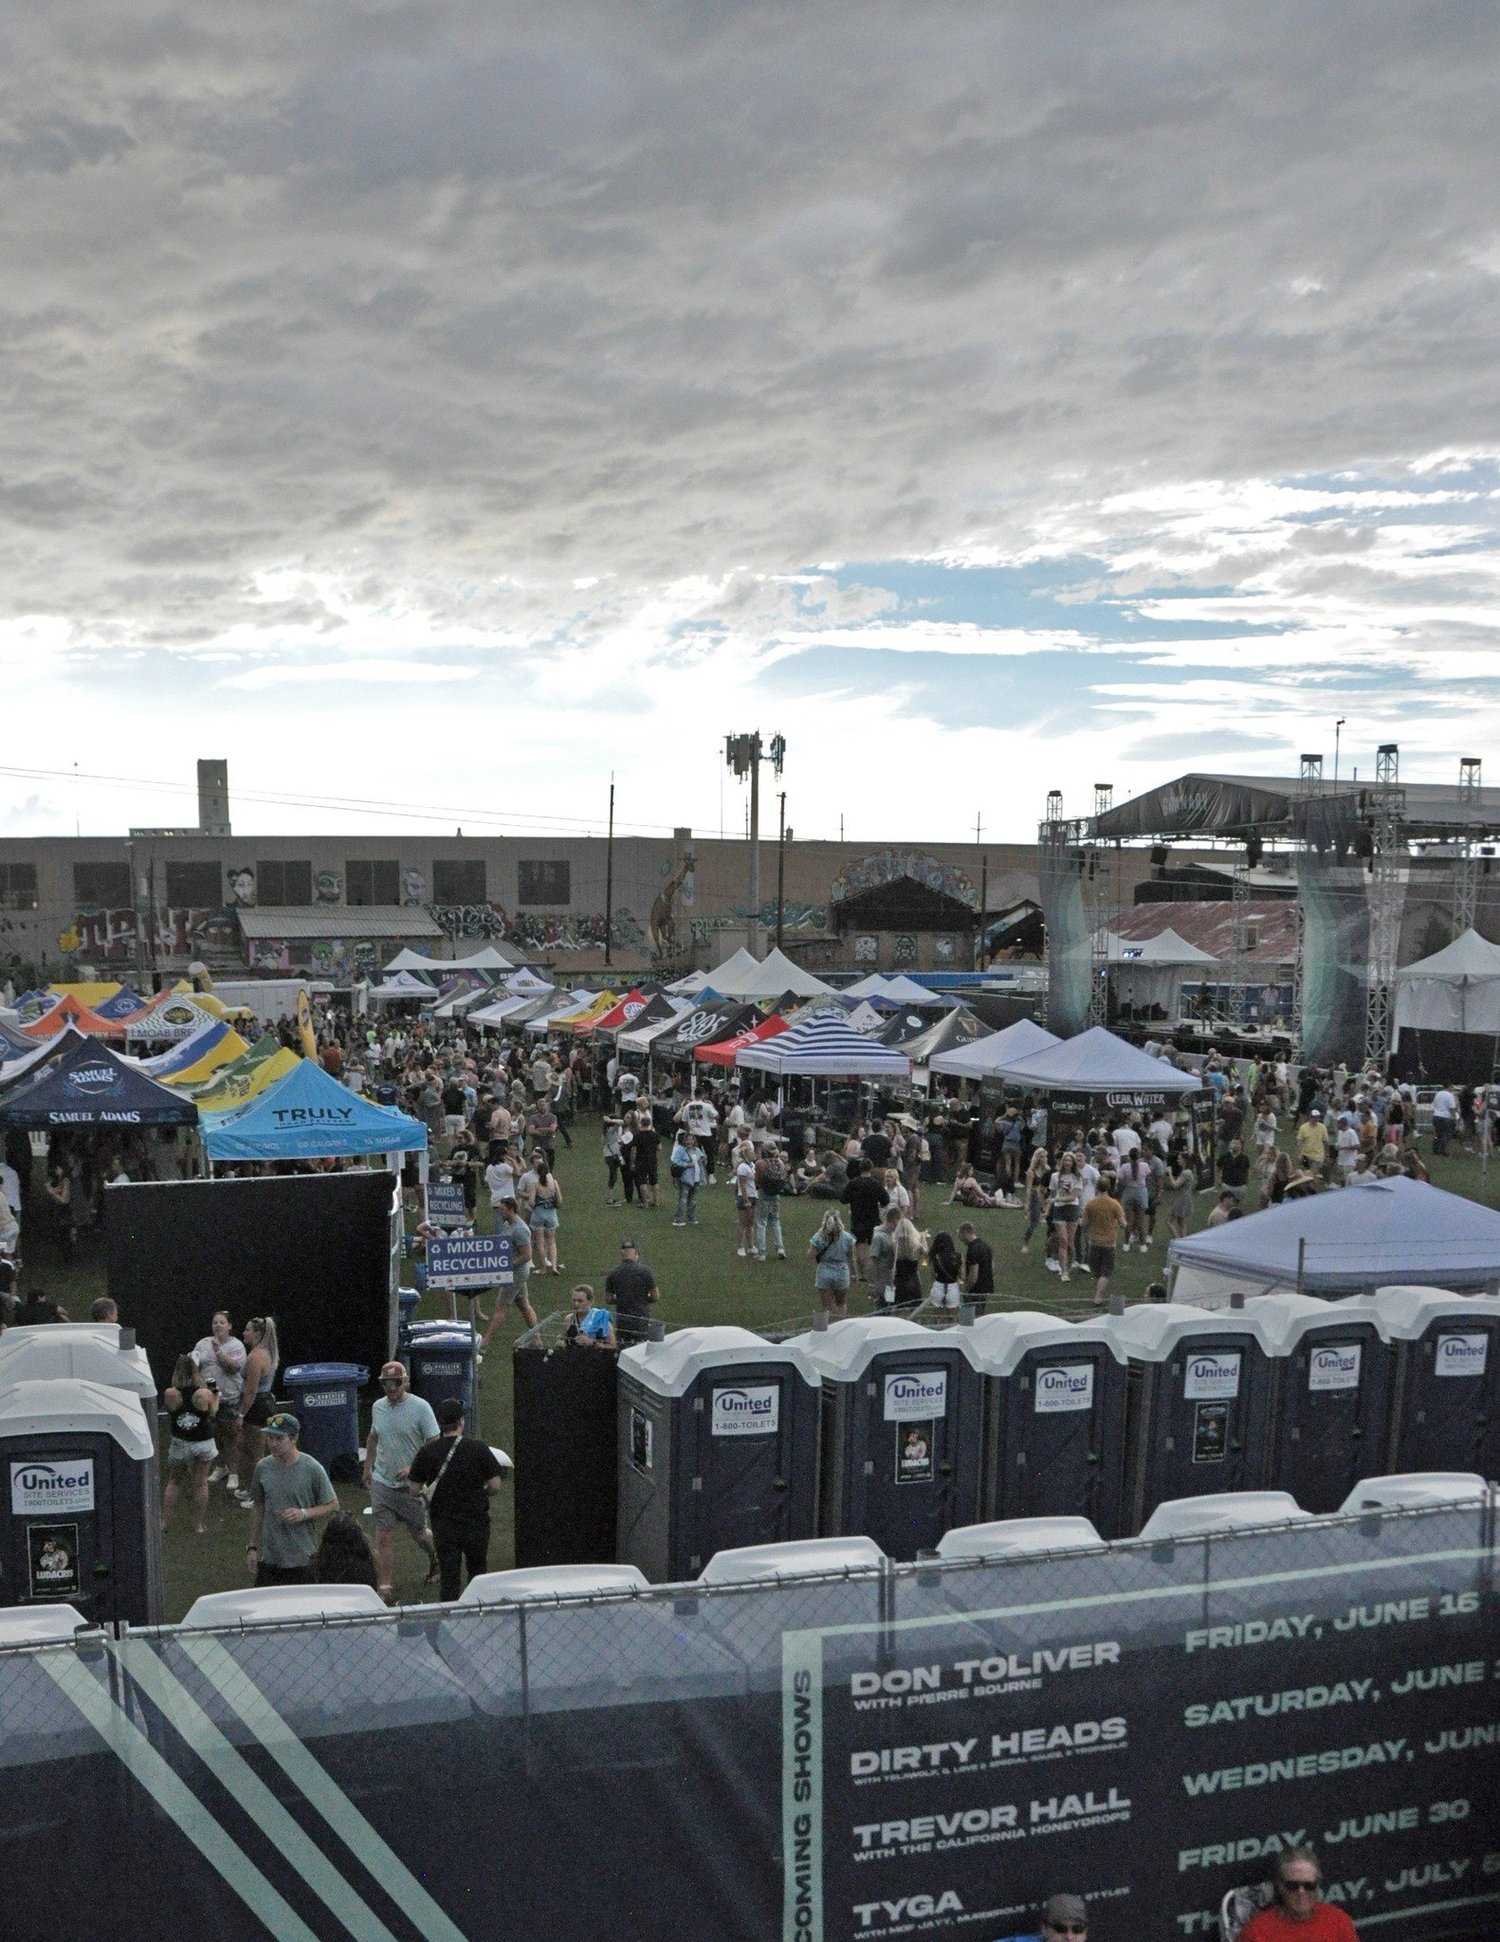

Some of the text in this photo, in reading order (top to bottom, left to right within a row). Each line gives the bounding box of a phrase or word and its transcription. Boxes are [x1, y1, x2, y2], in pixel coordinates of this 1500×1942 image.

[174, 1028, 197, 1037] BRE
[69, 1067, 118, 1080] SAMUEL
[73, 1074, 114, 1084] ADAMS
[1106, 1091, 1165, 1107] CLEAR WATER
[49, 1110, 140, 1124] SAMUEL ADAMS
[272, 1107, 353, 1122] TRULY
[434, 1186, 455, 1197] MIXED
[429, 1200, 463, 1211] RECYCLING
[447, 1240, 494, 1254] MIXED
[432, 1255, 509, 1272] RECYCLING
[1444, 1343, 1485, 1357] United
[1318, 1354, 1356, 1369] United
[1194, 1363, 1237, 1378] United
[894, 1382, 943, 1398] United
[1044, 1374, 1088, 1390] United
[721, 1396, 772, 1412] United
[715, 1419, 776, 1430] 1-800-TOILETS
[22, 1471, 89, 1490] United
[24, 1488, 90, 1499] SITE SERVICES
[36, 1569, 74, 1580] LUDACRIS
[1185, 1591, 1479, 1653] FRIDAY, JUNE 16
[851, 1641, 1121, 1696] DON TOLIVER
[854, 1678, 1042, 1711] WITH PIERRE BOURNE
[1184, 1677, 1381, 1728] SATURDAY,
[1390, 1660, 1485, 1694] JUNE
[794, 1669, 812, 1802] SHOWS
[851, 1717, 1127, 1776] DIRTY HEADS
[1182, 1723, 1500, 1796] WEDNESDAY, JUN
[853, 1787, 1131, 1848] TREVOR HALL
[854, 1810, 1131, 1862] WITH THE CALIFORNIA HONEYDROPS
[1177, 1799, 1471, 1872] FRIDAY, JUNE 30
[1385, 1858, 1470, 1893] JULY
[853, 1890, 963, 1926] TYGA
[854, 1926, 886, 1940] WITH
